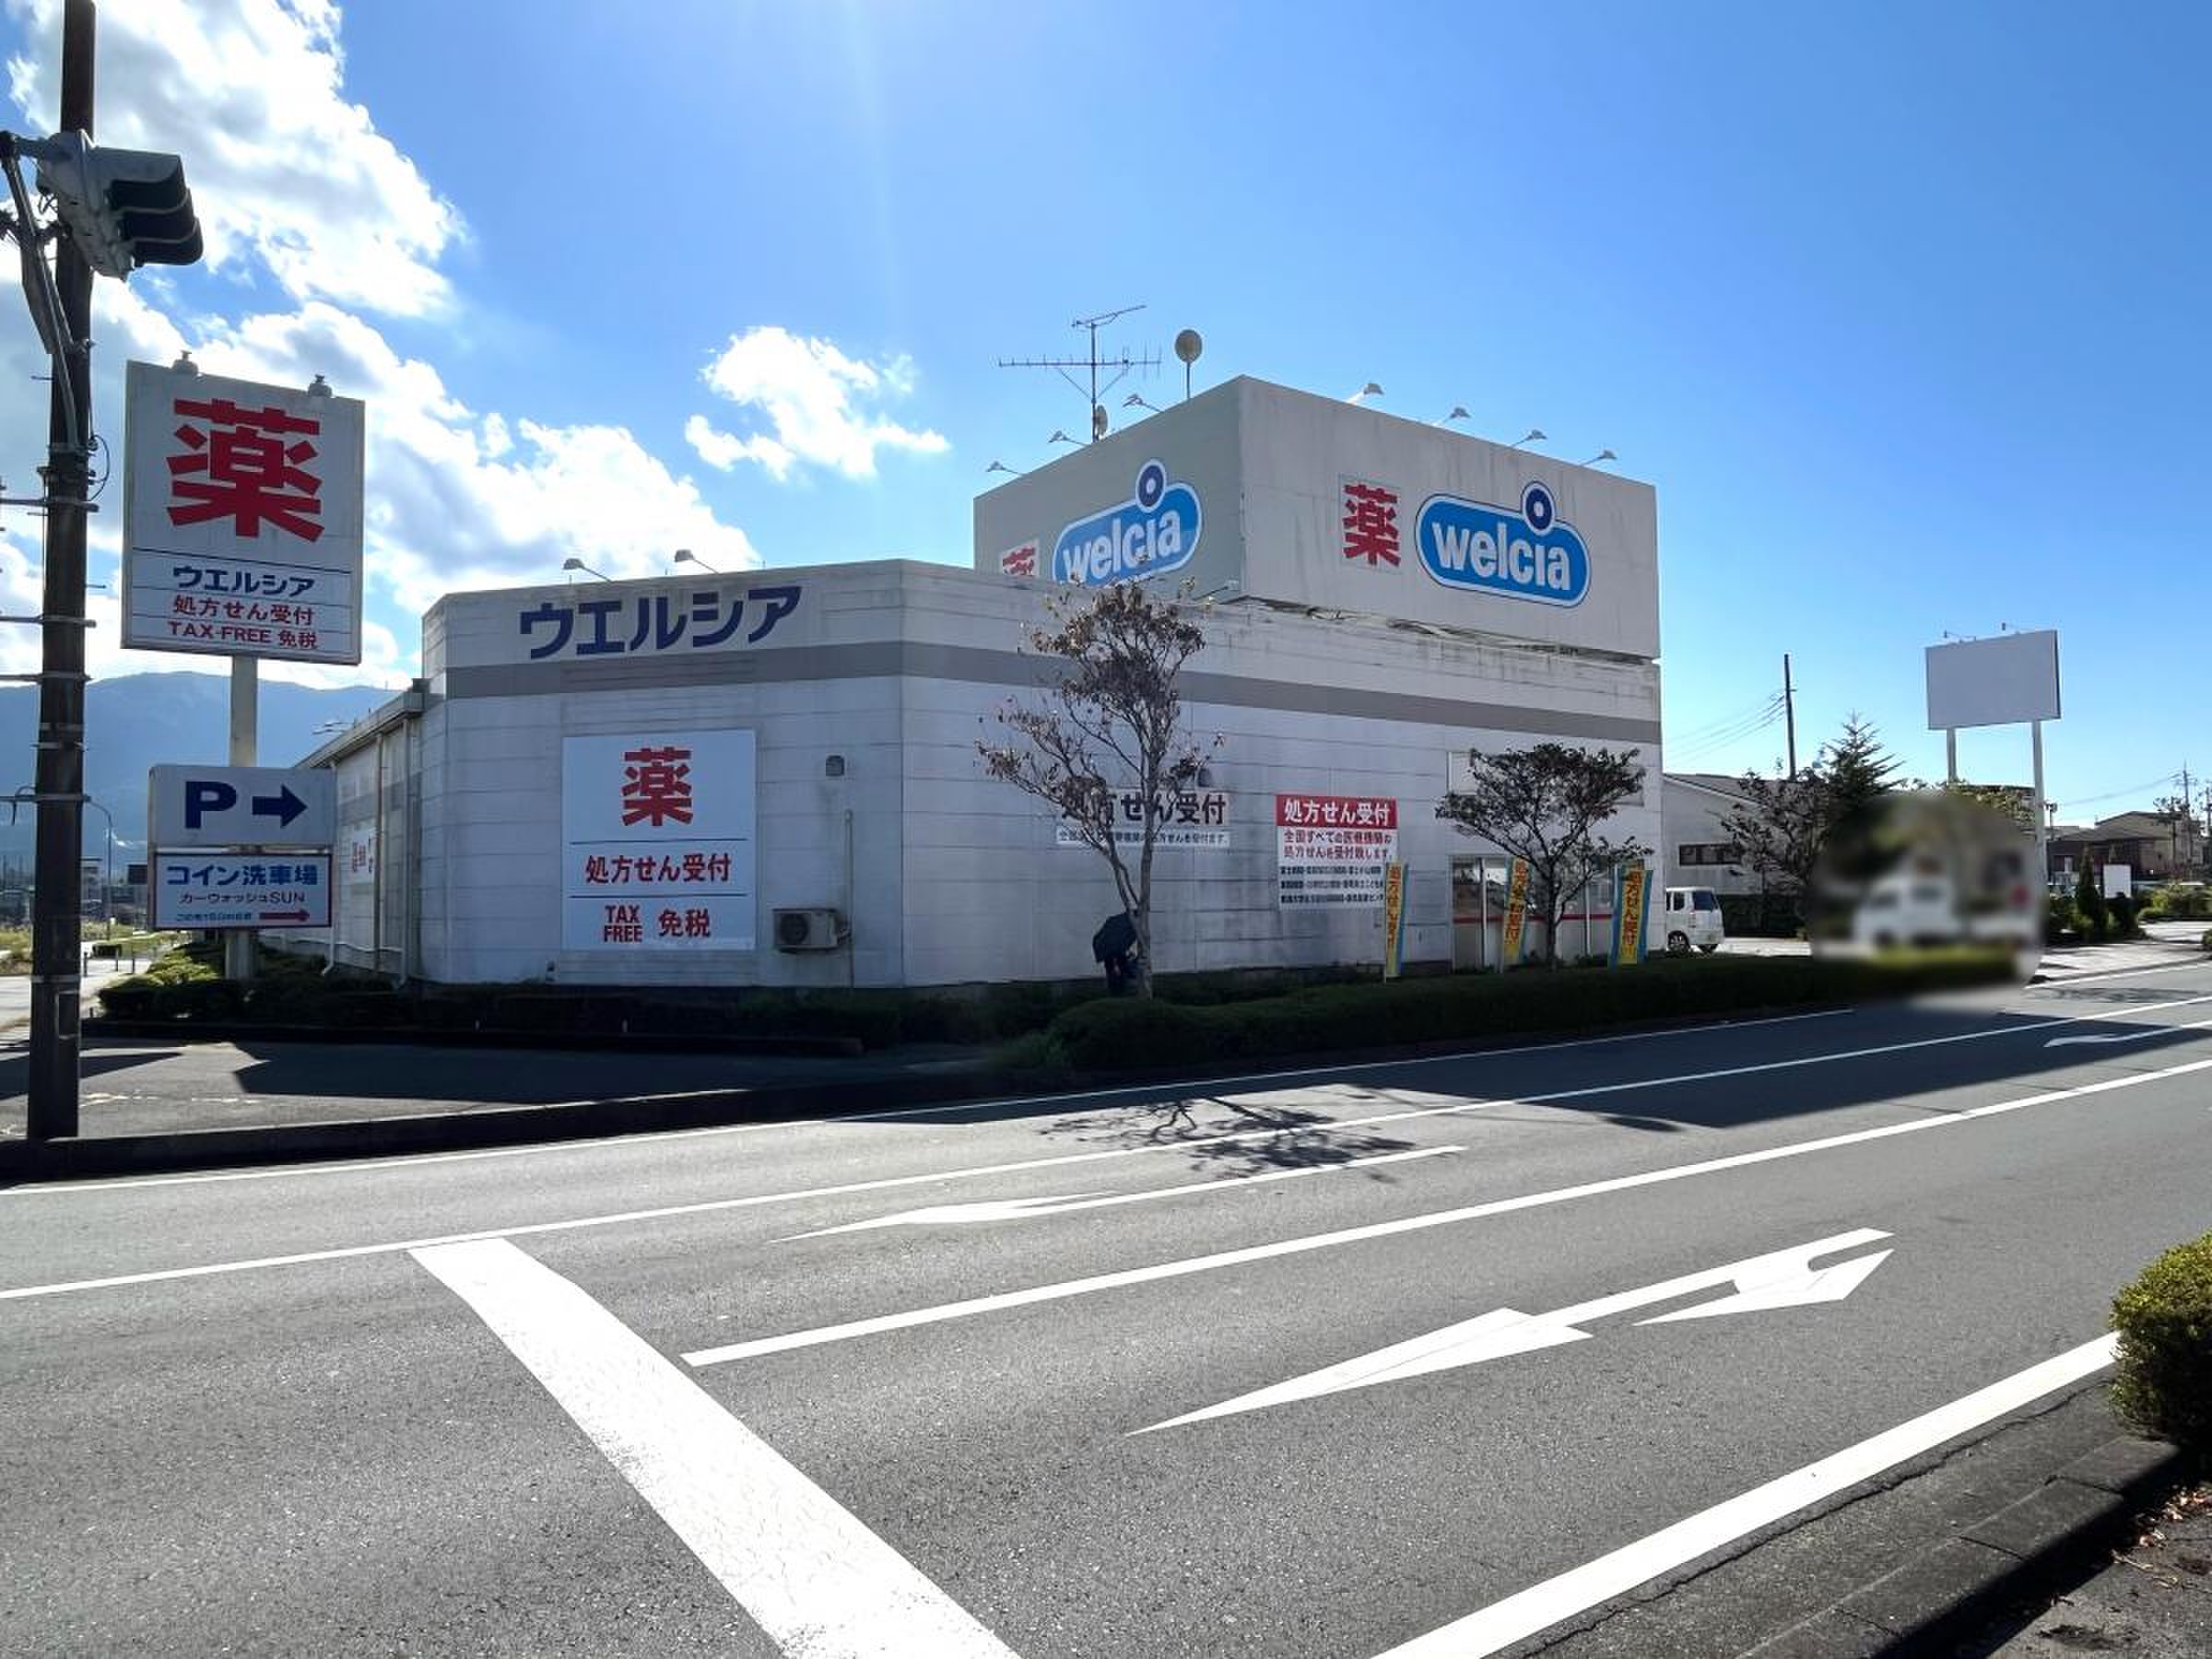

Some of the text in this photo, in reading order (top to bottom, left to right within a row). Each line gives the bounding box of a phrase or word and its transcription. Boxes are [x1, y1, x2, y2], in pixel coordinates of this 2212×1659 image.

[166, 398, 324, 543] 薬
[1064, 465, 1181, 582] welcia
[1342, 483, 1401, 567] 薬
[1431, 484, 1571, 591] welcia
[173, 566, 314, 596] ウエルシア
[173, 594, 313, 626] 処方せん受付
[519, 586, 802, 659] ウエルシア
[277, 629, 318, 650] 免税
[621, 747, 693, 826] 薬
[185, 782, 237, 829] P
[1062, 792, 1226, 824] せん受付
[1284, 797, 1390, 826] 処方せん受付
[167, 865, 318, 886] コイン洗車場
[585, 853, 732, 884] 処方せん受付
[605, 905, 641, 924] TAX
[658, 909, 711, 938] 免税
[604, 925, 642, 943] FREE
